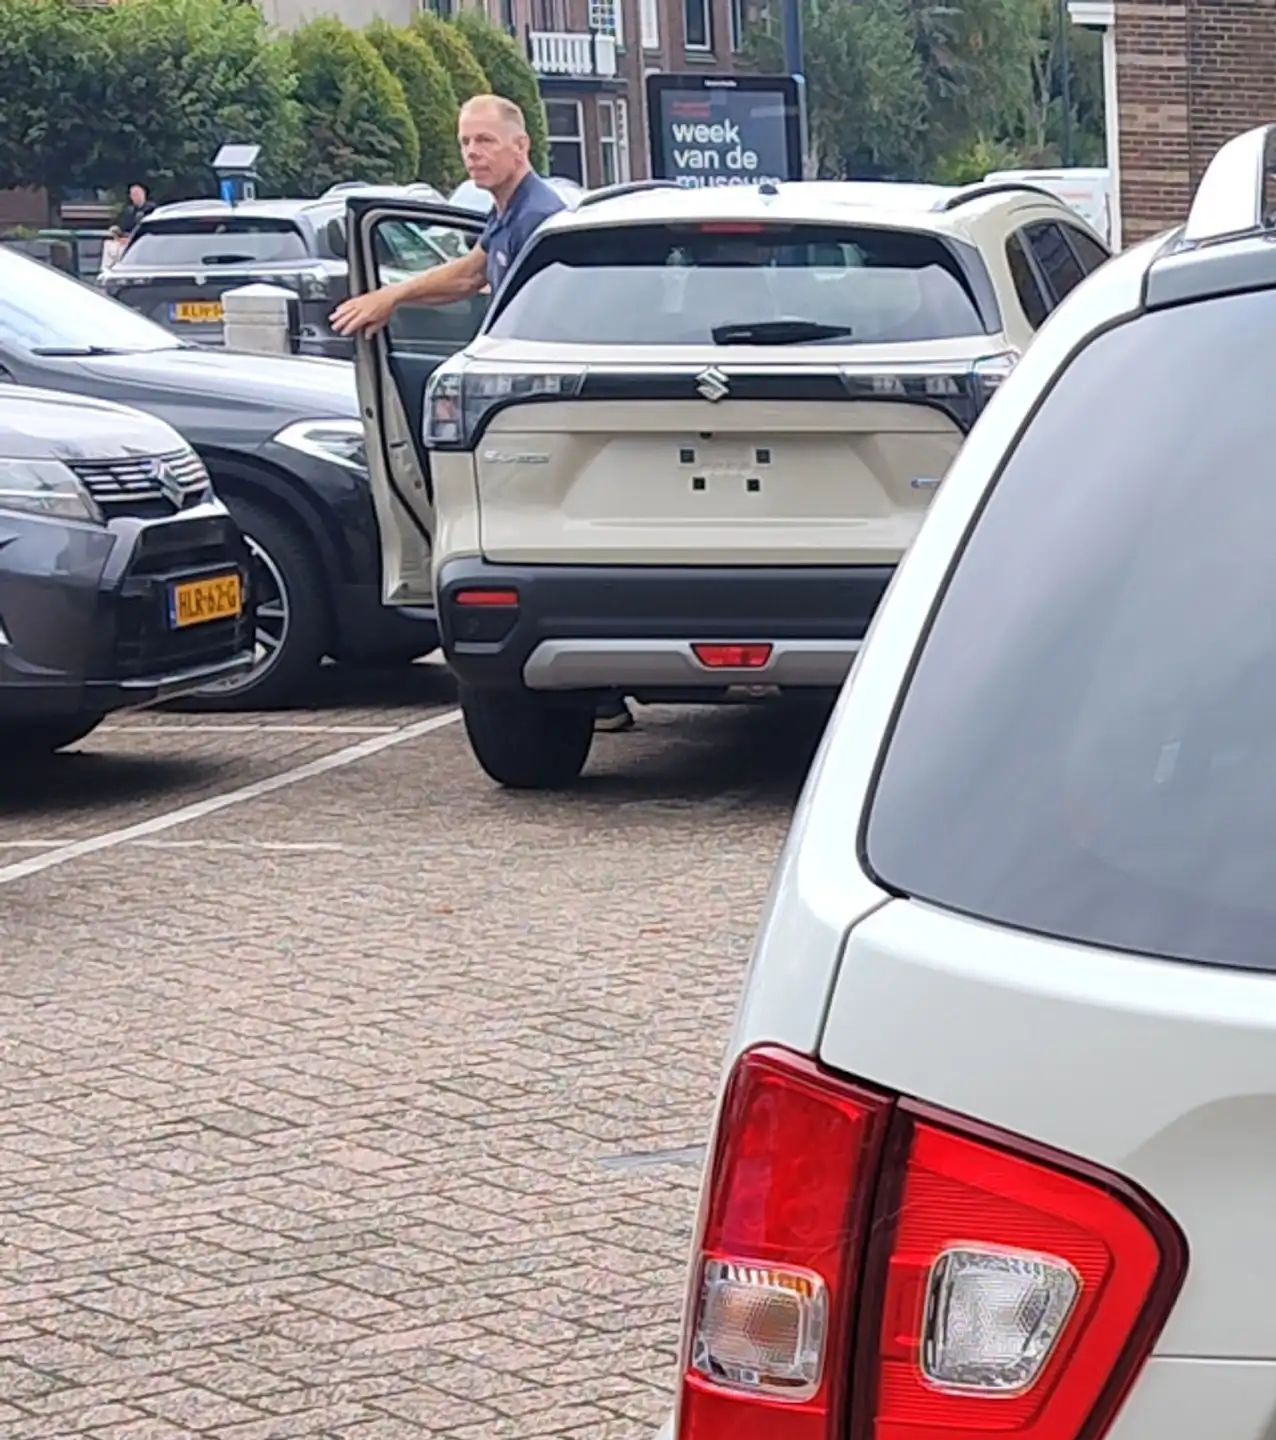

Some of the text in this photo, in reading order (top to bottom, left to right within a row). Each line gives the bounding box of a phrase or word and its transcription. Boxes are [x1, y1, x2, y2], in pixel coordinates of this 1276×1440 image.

[672, 118, 739, 143] week
[673, 145, 758, 170] van de
